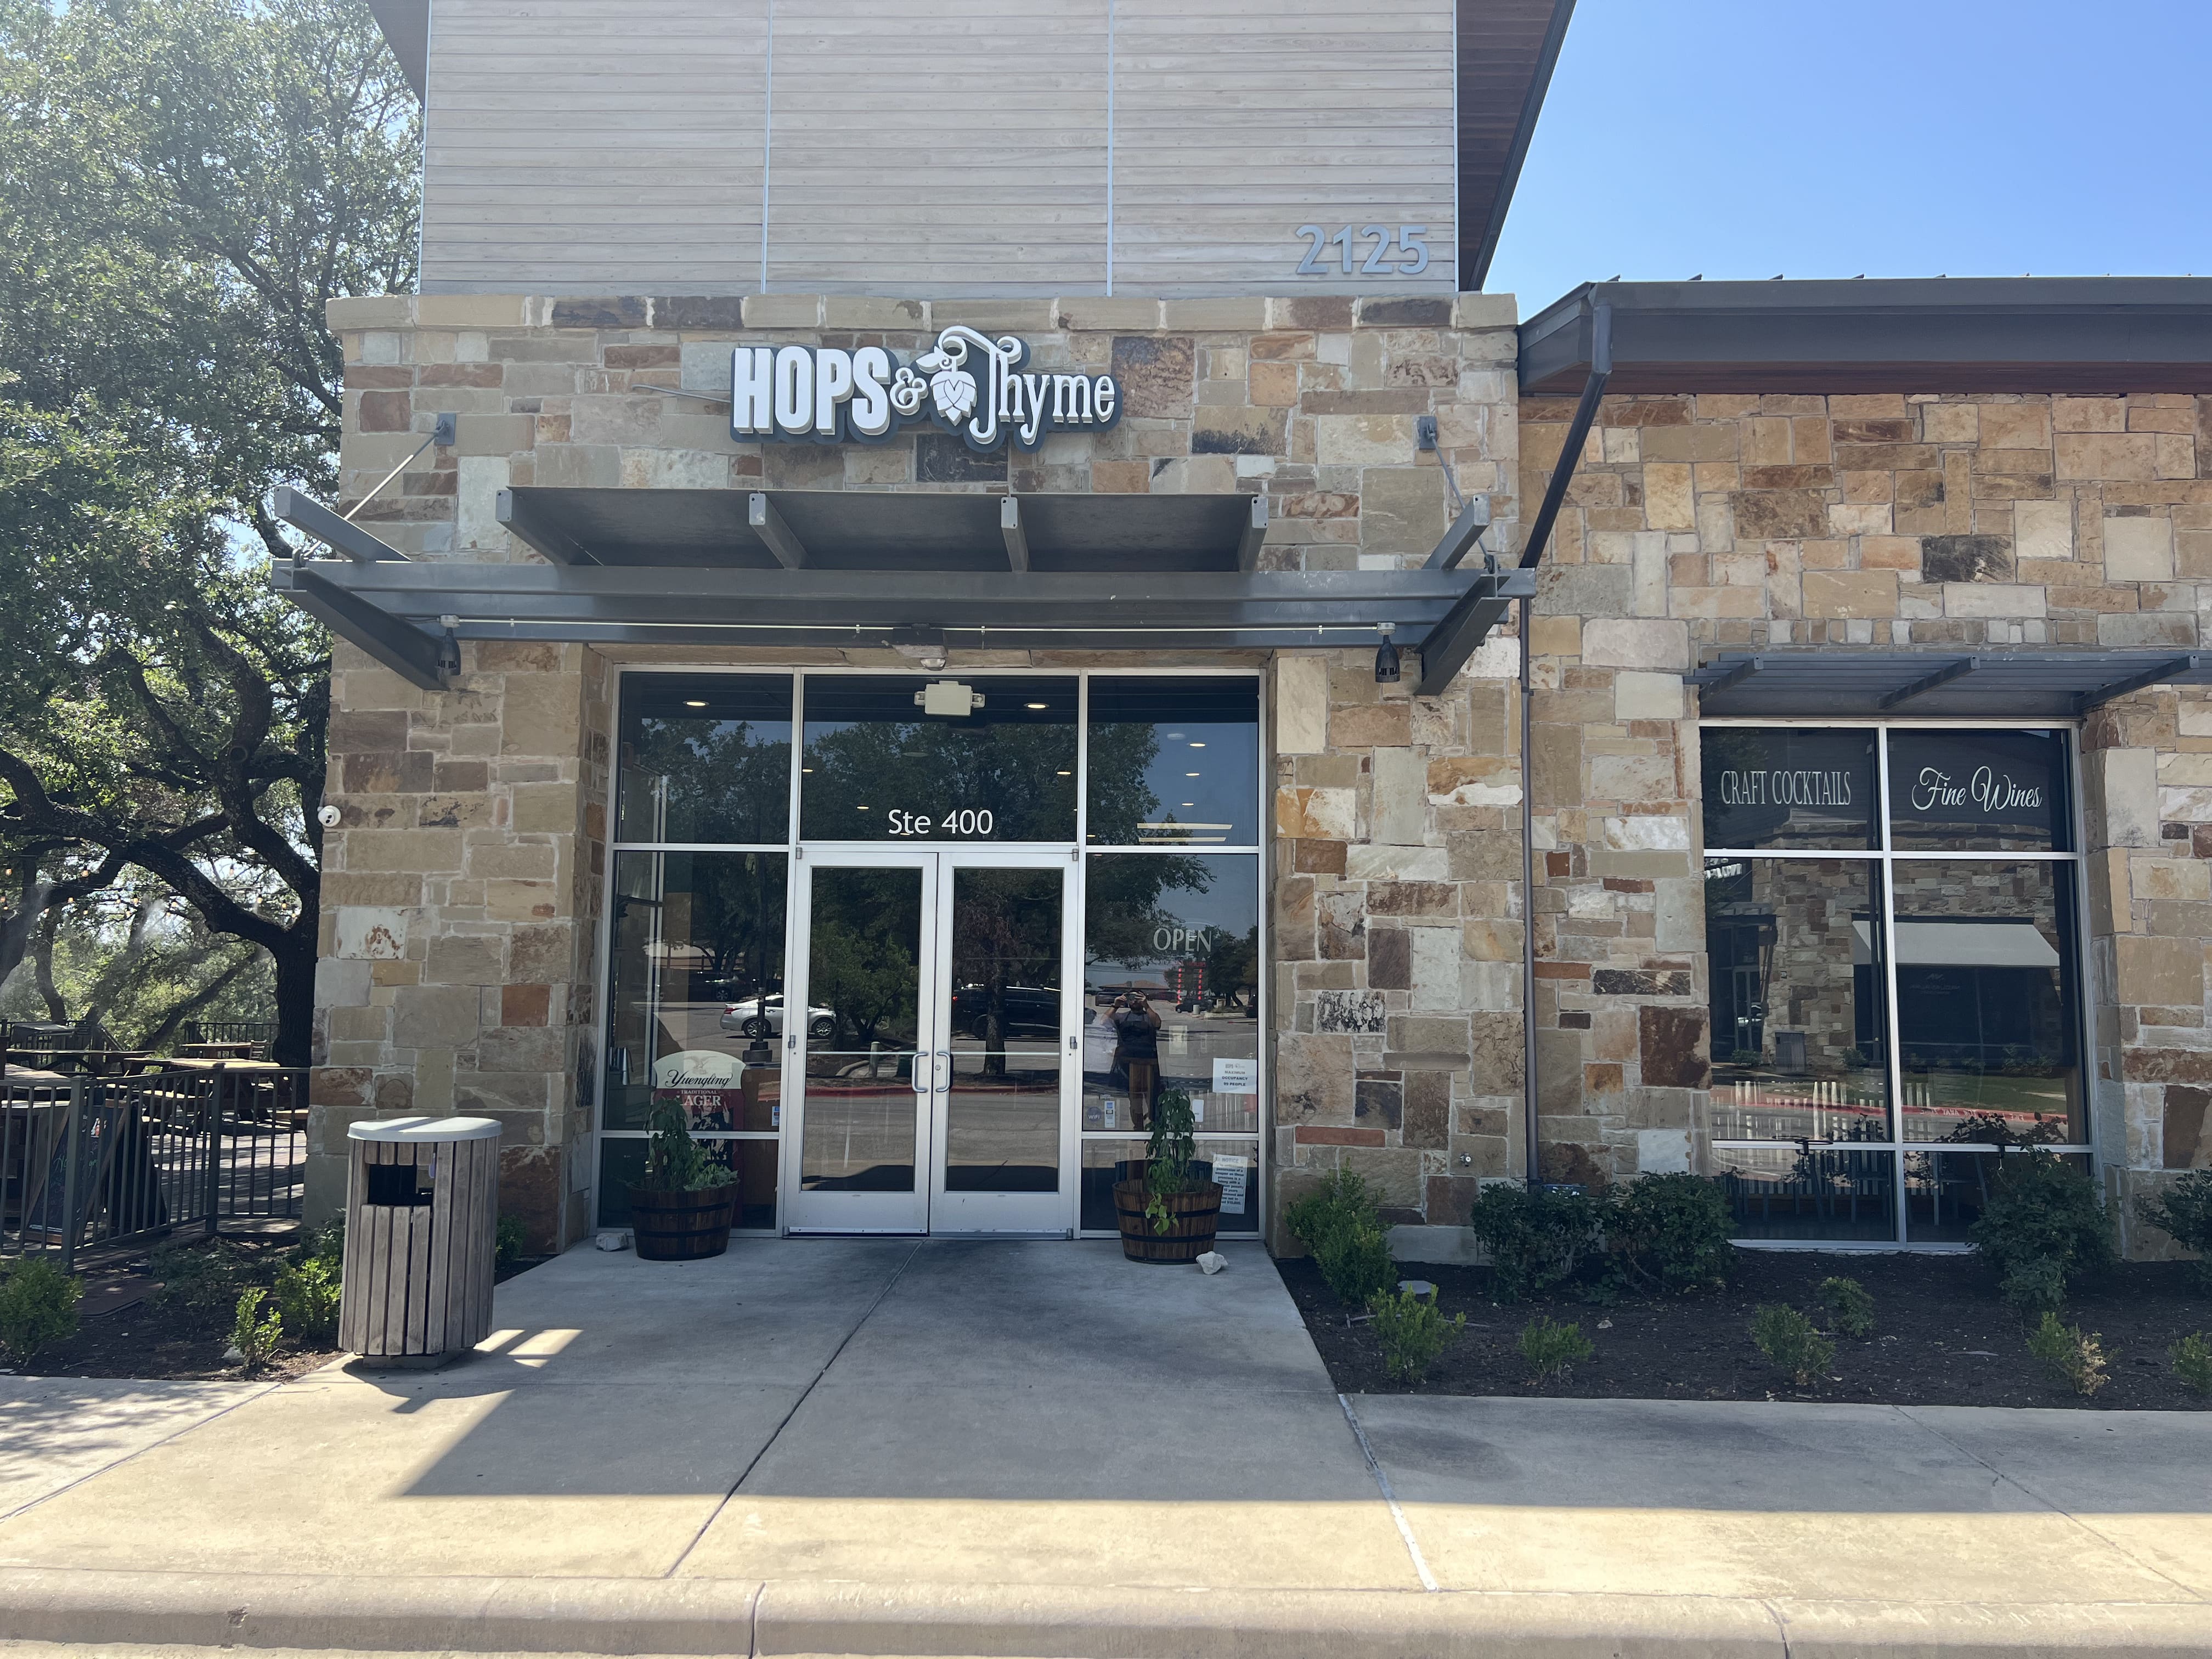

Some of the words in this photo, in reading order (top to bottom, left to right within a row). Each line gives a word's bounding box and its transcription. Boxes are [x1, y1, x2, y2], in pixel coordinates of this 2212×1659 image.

[1295, 224, 1429, 274] 2125
[733, 346, 891, 436] HOPS
[890, 367, 929, 416] &
[938, 325, 1115, 445] Thyme
[1720, 770, 1767, 805] CRAFT
[1771, 770, 1851, 806] COCKTAILS
[1911, 766, 1966, 811] Fine
[1971, 765, 2042, 812] Wines
[888, 809, 932, 834] Ste
[941, 809, 993, 834] 400
[1153, 927, 1212, 952] OPEN
[665, 1069, 733, 1088] Yuengling
